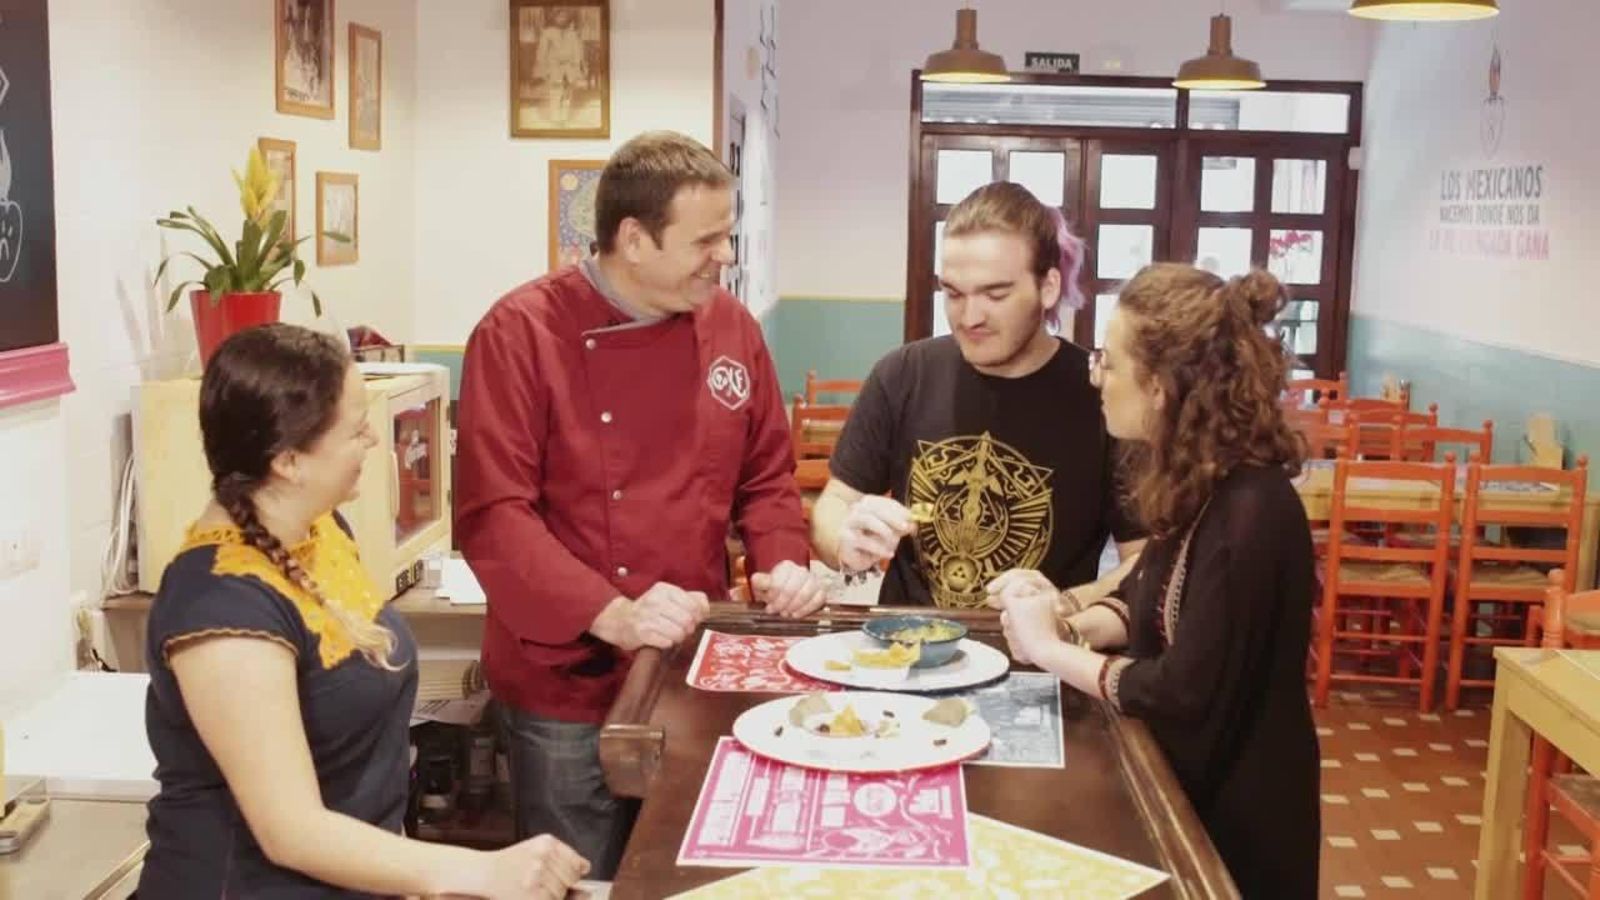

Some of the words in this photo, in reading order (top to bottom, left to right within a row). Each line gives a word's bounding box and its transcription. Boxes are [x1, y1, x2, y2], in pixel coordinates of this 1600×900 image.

[1031, 57, 1073, 70] SALIDA
[1441, 170, 1461, 201] LOS
[1466, 165, 1543, 200] MEXICANOS
[1507, 204, 1524, 225] NOS
[1527, 204, 1540, 225] DA
